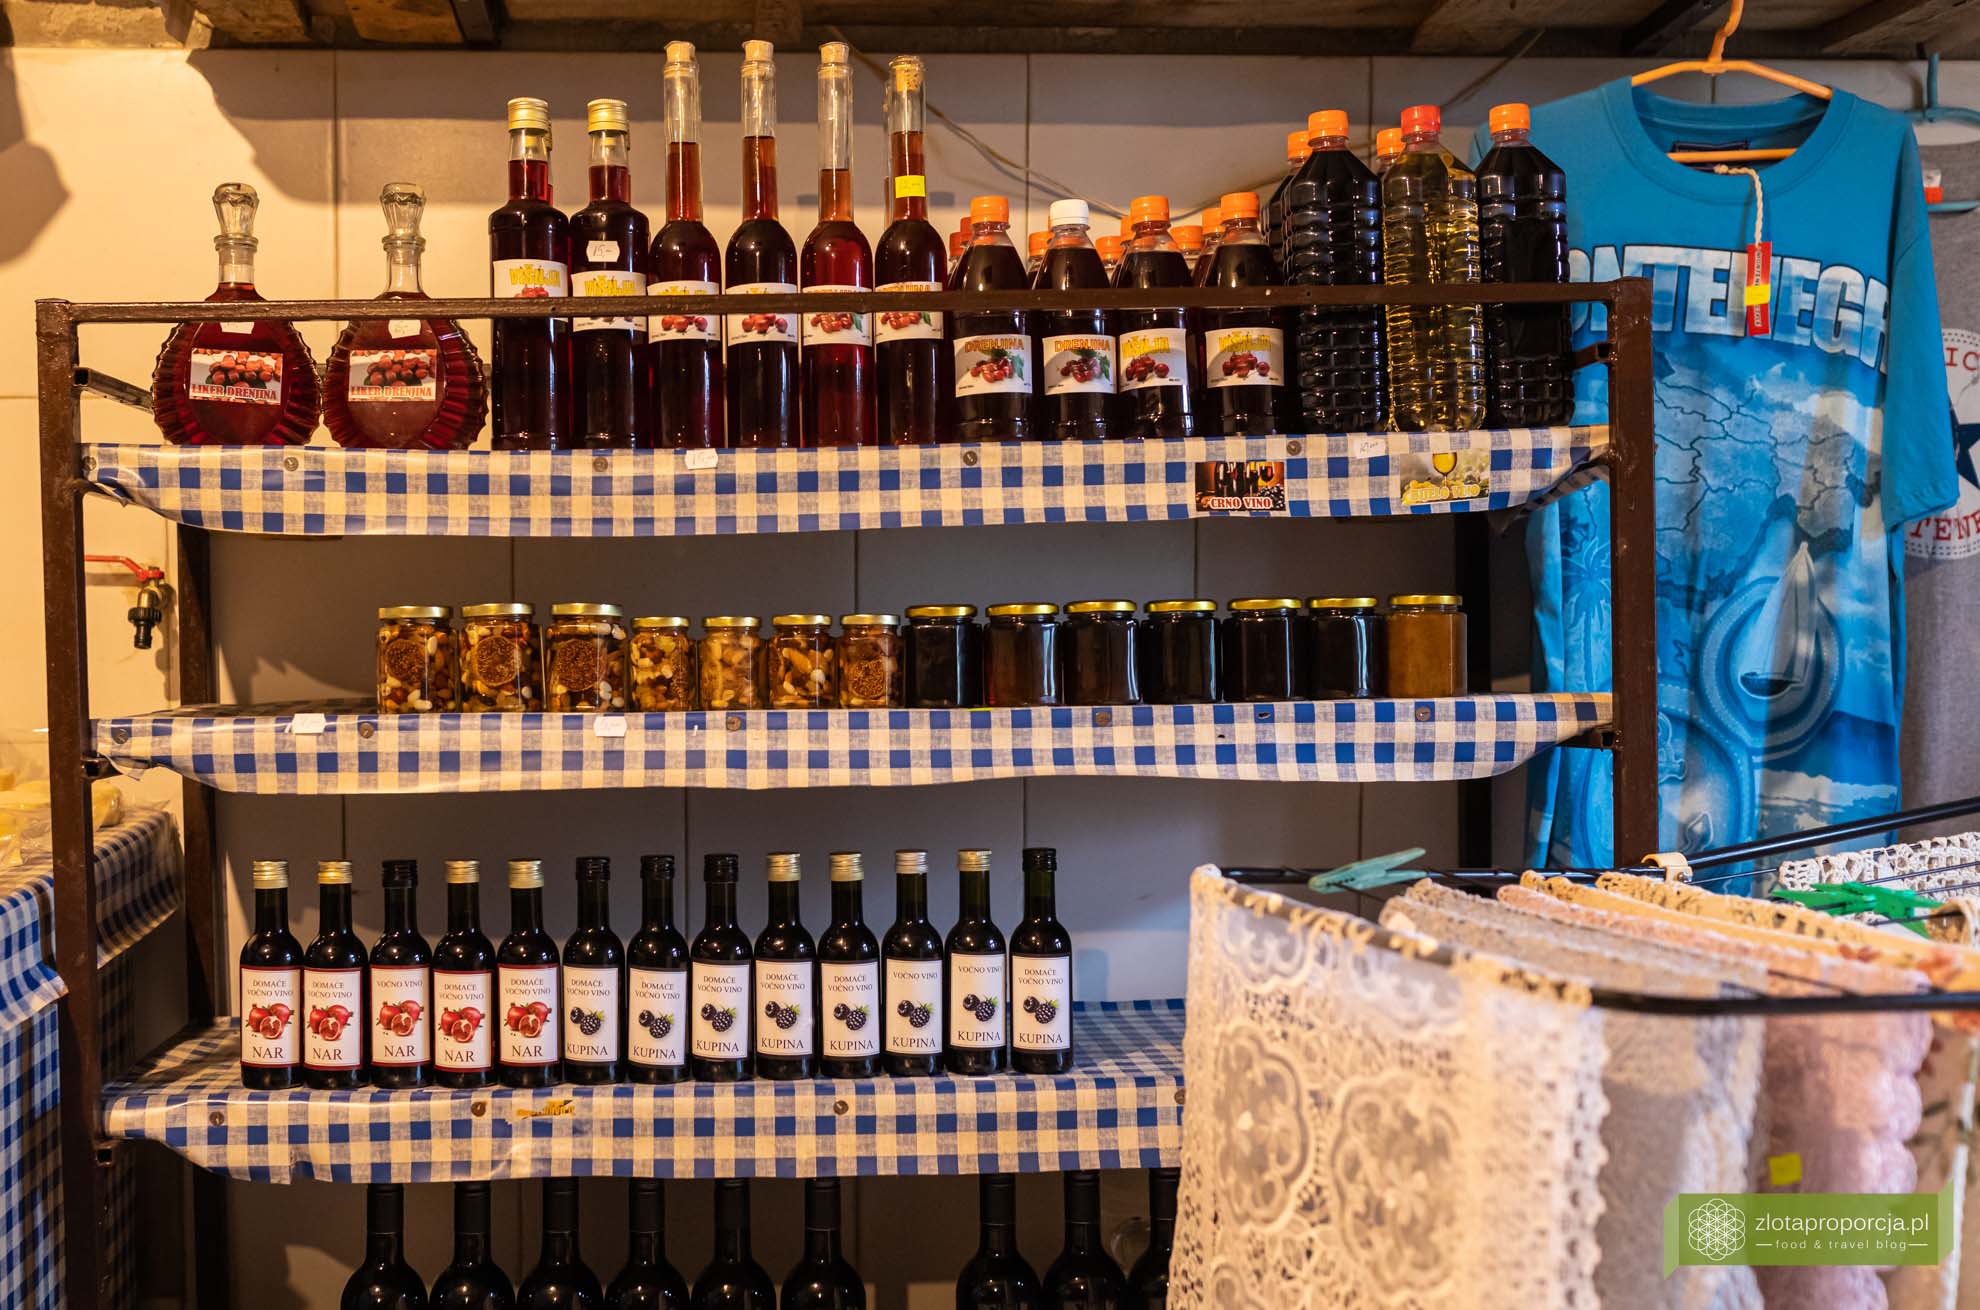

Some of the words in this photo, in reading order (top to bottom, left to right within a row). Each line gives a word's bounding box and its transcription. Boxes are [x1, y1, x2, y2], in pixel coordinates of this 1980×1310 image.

[192, 384, 224, 396] LIKER
[227, 386, 277, 400] DRENJINA
[351, 386, 381, 397] LIKER
[383, 386, 432, 398] DRENJINA
[1451, 484, 1480, 498] VINO
[1210, 498, 1241, 509] CRNO
[1243, 497, 1273, 509] VINO
[921, 972, 938, 980] VINO
[1046, 977, 1064, 985] VINO
[404, 980, 423, 988] VINO
[724, 985, 743, 994] VINO
[786, 983, 805, 991] VINO
[855, 984, 873, 993] VINO
[274, 989, 294, 998] VINO
[331, 991, 353, 1000] VINO
[465, 993, 485, 1001] VINO
[532, 987, 551, 996] VINO
[591, 988, 610, 997] VINO
[662, 991, 680, 1000] VINO
[892, 1036, 936, 1048] KUPINA
[957, 1030, 1001, 1042] KUPINA
[1019, 1032, 1063, 1044] KUPINA
[566, 1042, 608, 1056] KUPINA
[696, 1040, 739, 1052] KUPINA
[761, 1037, 804, 1049] KUPINA
[830, 1040, 874, 1051] KUPINA
[252, 1046, 284, 1060] NAR
[312, 1047, 343, 1061] NAR
[384, 1045, 416, 1057] NAR
[444, 1049, 475, 1063] NAR
[511, 1045, 544, 1057] NAR
[633, 1046, 677, 1059] KUPINA
